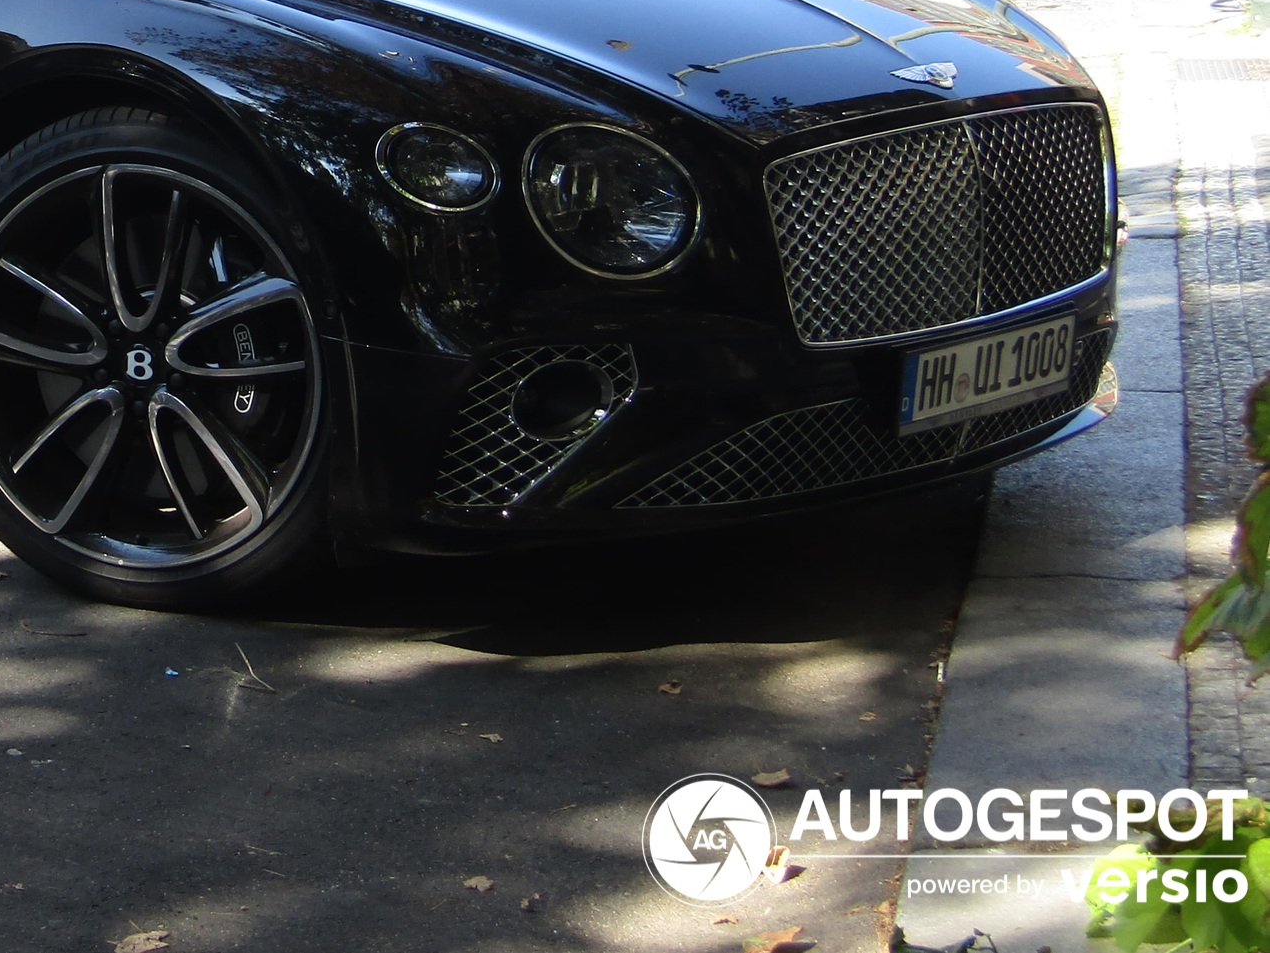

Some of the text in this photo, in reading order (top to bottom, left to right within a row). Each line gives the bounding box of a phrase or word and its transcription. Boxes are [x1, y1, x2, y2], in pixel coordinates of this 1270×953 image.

[918, 353, 957, 412] HH
[974, 340, 1005, 396] UI
[1007, 323, 1069, 388] 1008
